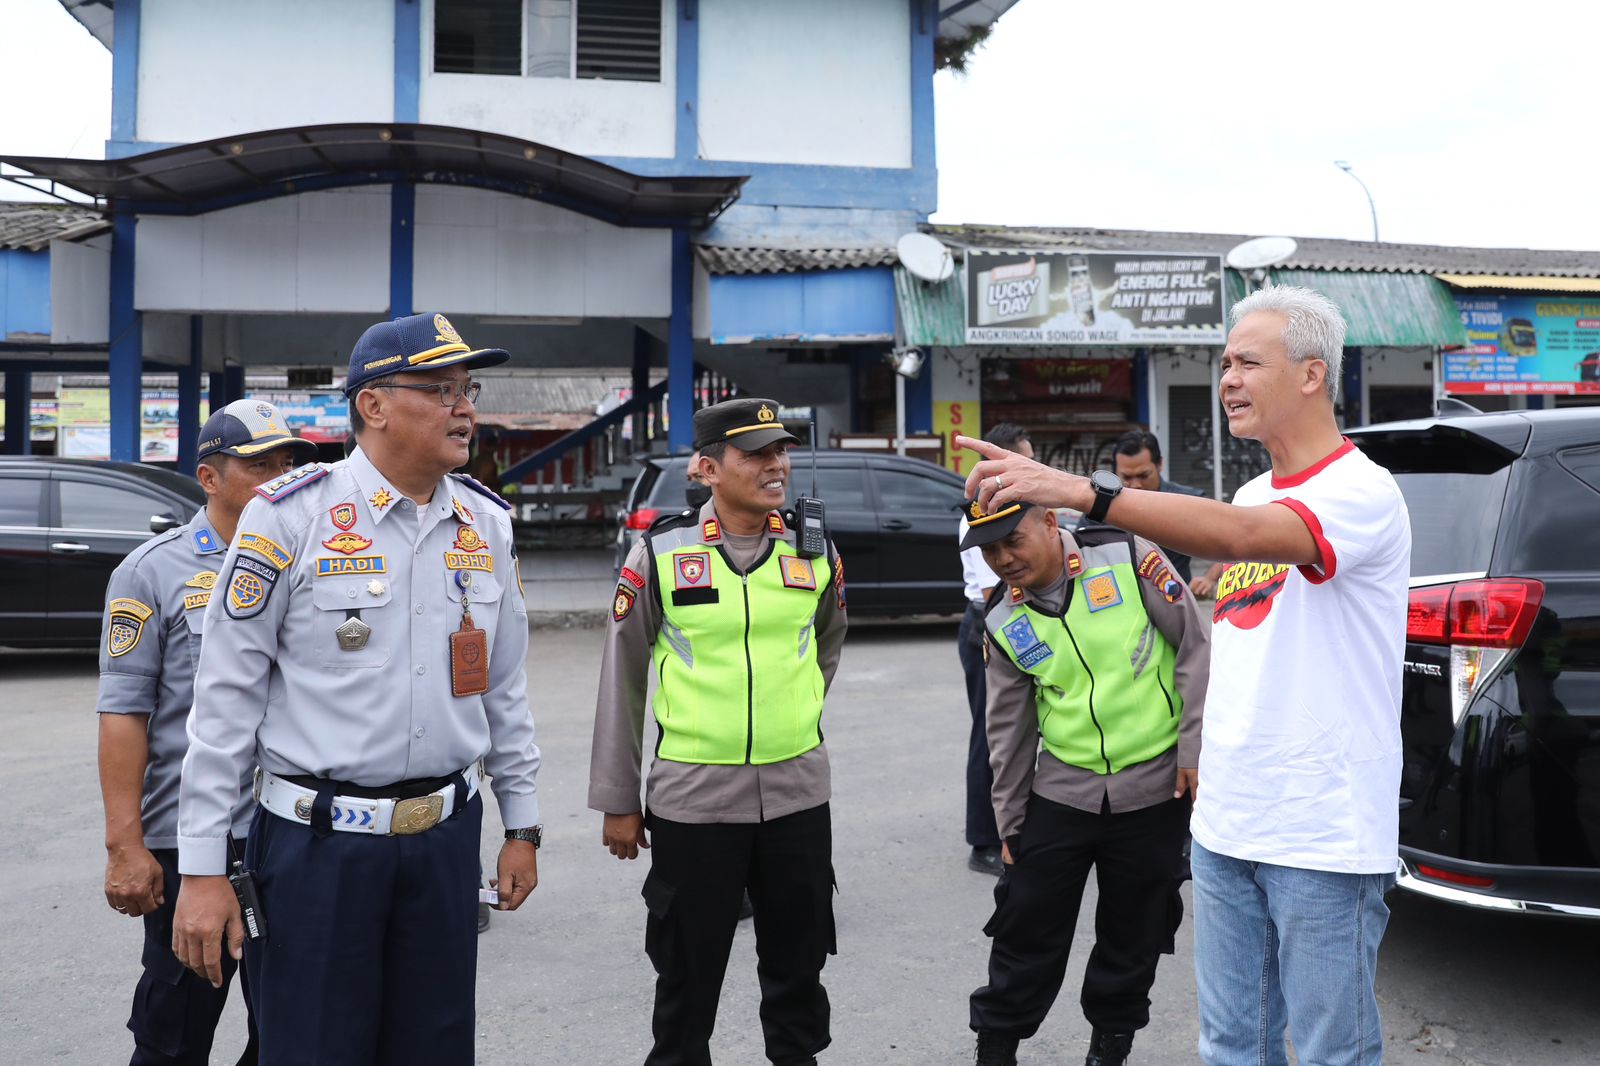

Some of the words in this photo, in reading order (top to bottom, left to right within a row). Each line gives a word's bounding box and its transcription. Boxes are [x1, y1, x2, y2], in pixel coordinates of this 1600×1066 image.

[1119, 274, 1168, 290] ENERGI
[1170, 273, 1207, 288] FULL
[988, 278, 1040, 306] LUCKY
[1111, 293, 1147, 308] ANTI
[1148, 290, 1214, 307] NGANTUK
[998, 296, 1032, 316] DAY
[970, 329, 1043, 341] ANGKRINGAN
[1046, 330, 1084, 341] SONGO
[1088, 330, 1120, 341] WAGE
[237, 556, 275, 581] PERHUBUNGAN
[328, 558, 375, 572] HADI
